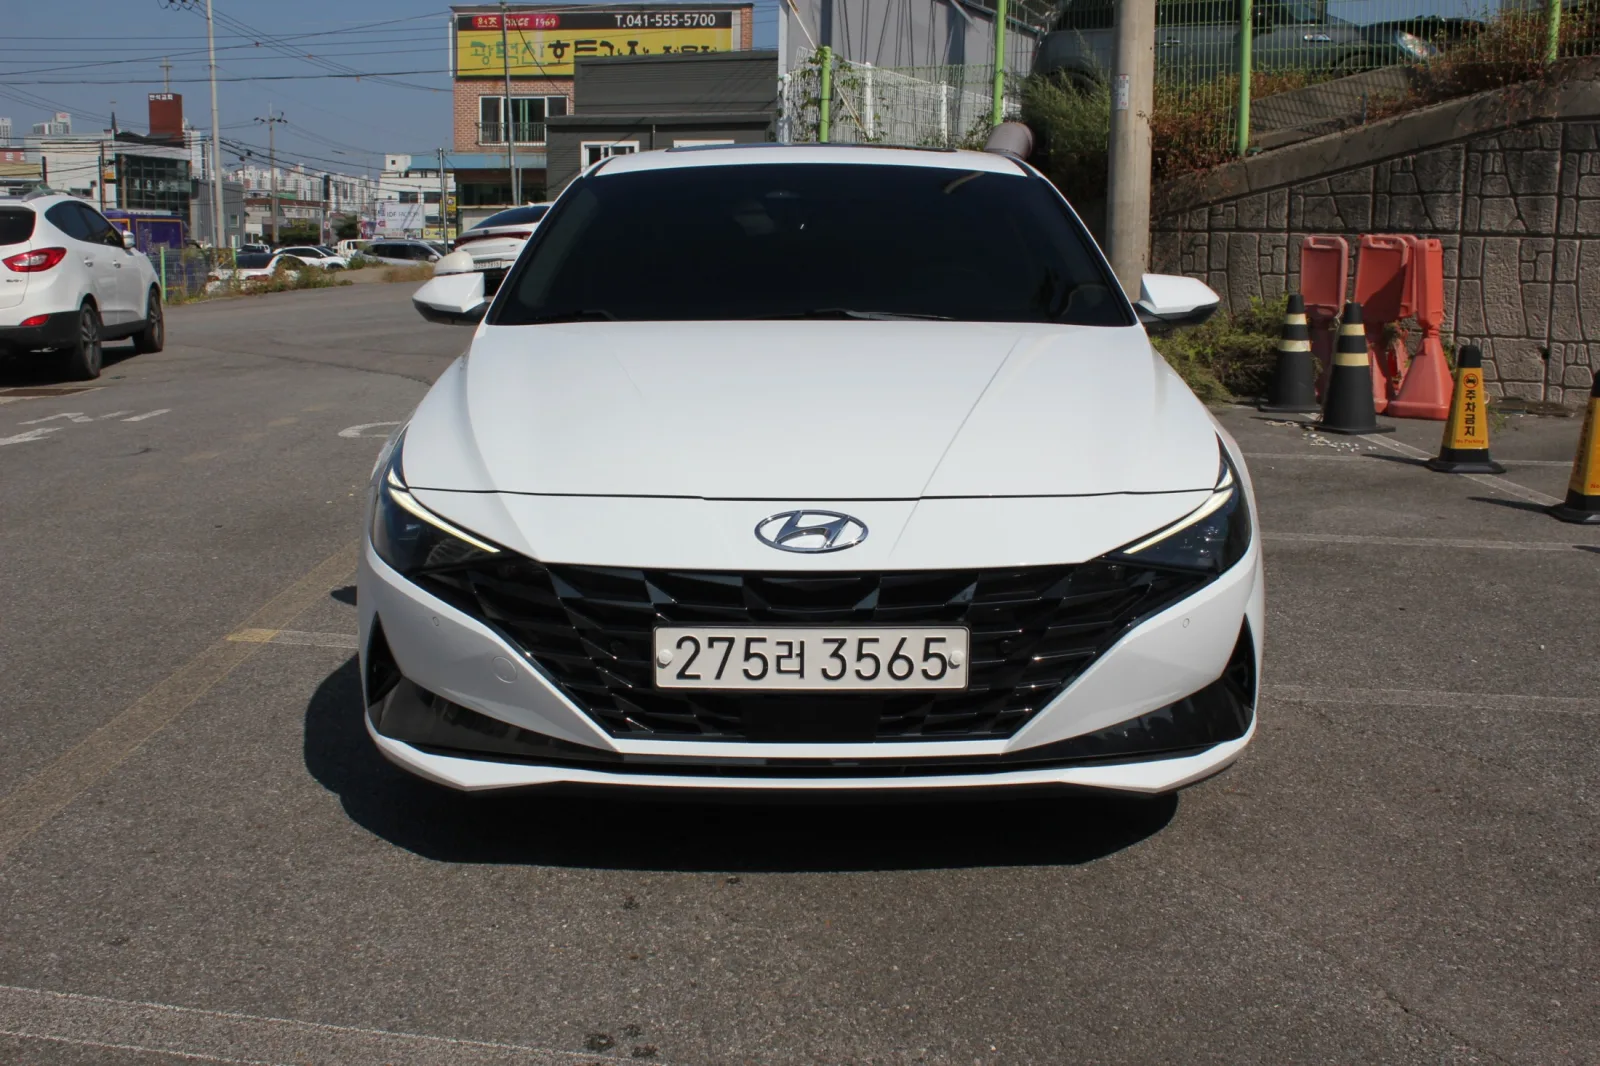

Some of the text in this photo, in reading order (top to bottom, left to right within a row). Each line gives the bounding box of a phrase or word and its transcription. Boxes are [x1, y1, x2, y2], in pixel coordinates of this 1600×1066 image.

[536, 18, 556, 27] 1969
[615, 14, 716, 28] T.041-555-5700
[1464, 389, 1476, 437] 주차금지
[675, 635, 948, 681] 275러 3565
